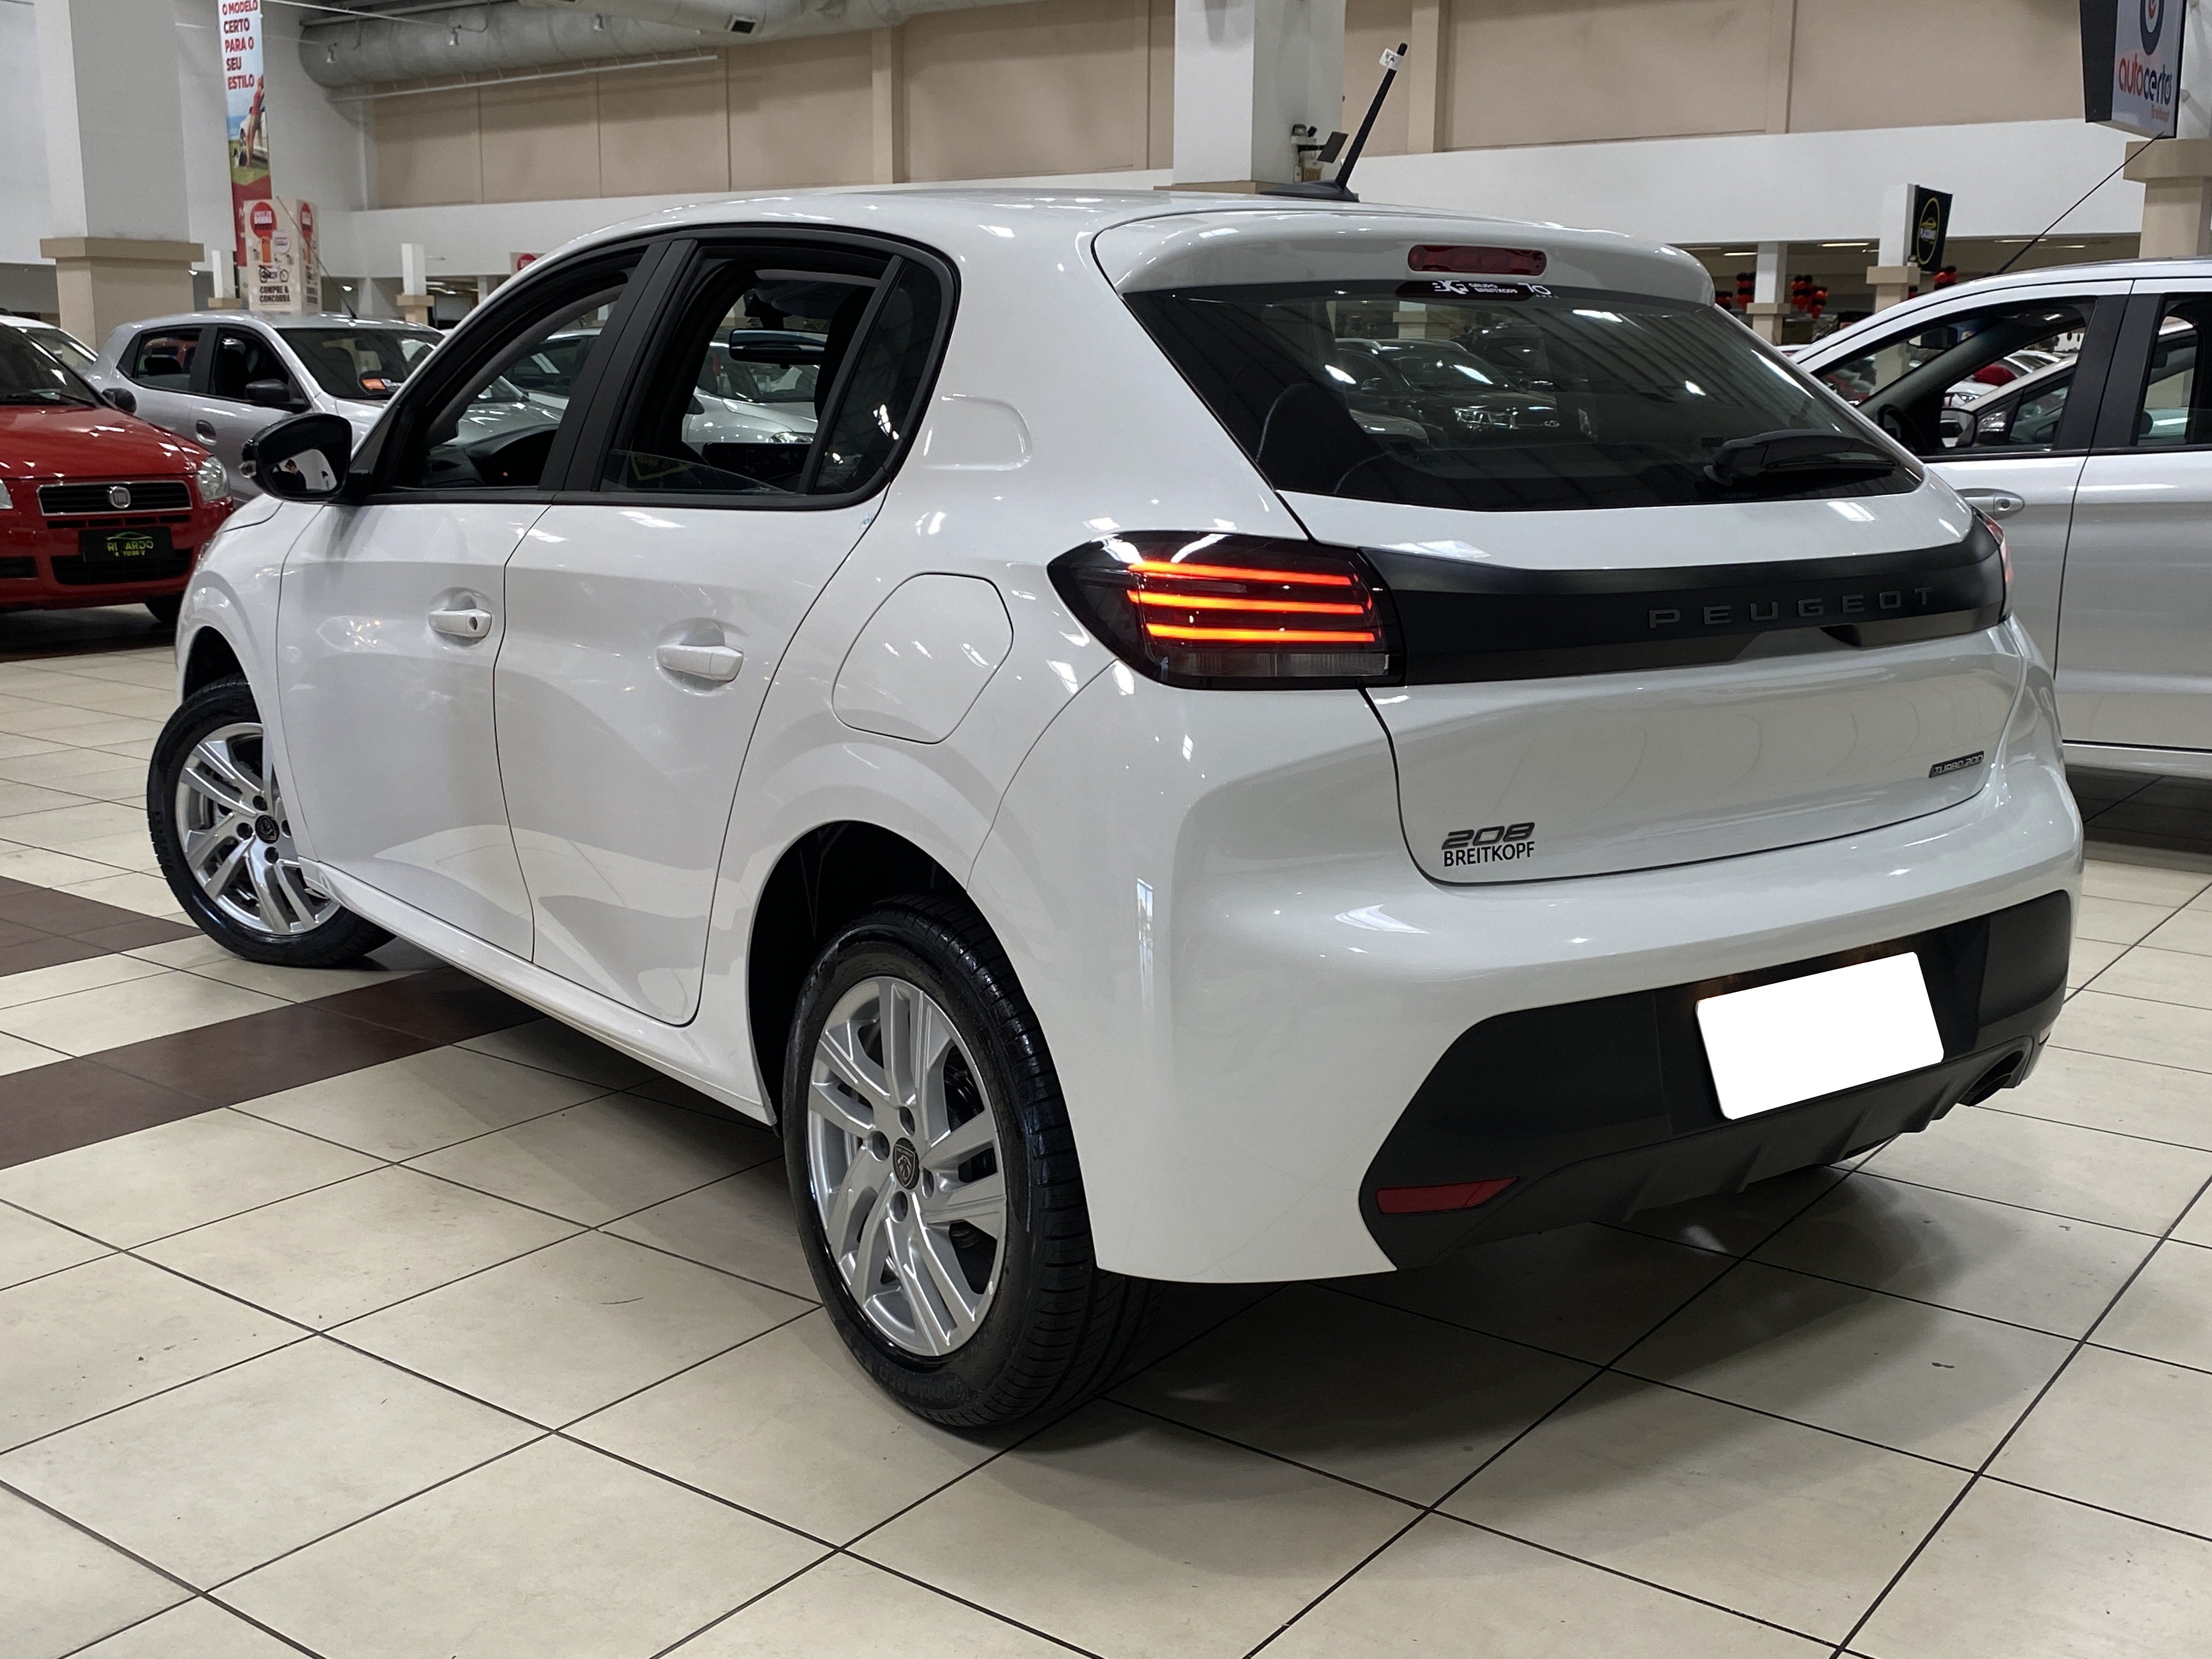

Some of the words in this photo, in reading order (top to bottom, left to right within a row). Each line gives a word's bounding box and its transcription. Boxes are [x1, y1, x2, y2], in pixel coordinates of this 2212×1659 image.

[222, 3, 228, 15] O
[228, 0, 258, 14] MODELO
[224, 18, 250, 33] CERTO
[224, 37, 246, 53] PARA
[248, 37, 254, 50] O
[226, 57, 241, 71] SEU
[228, 74, 254, 90] ESTILO
[2118, 54, 2172, 105] autocerto
[107, 540, 154, 551] RIARDO
[1649, 586, 1933, 629] PEUGEOT
[1935, 760, 1964, 774] TURBO
[1964, 755, 1983, 766] 200
[1441, 822, 1536, 850] 208
[1444, 841, 1535, 867] BREITKOPF
